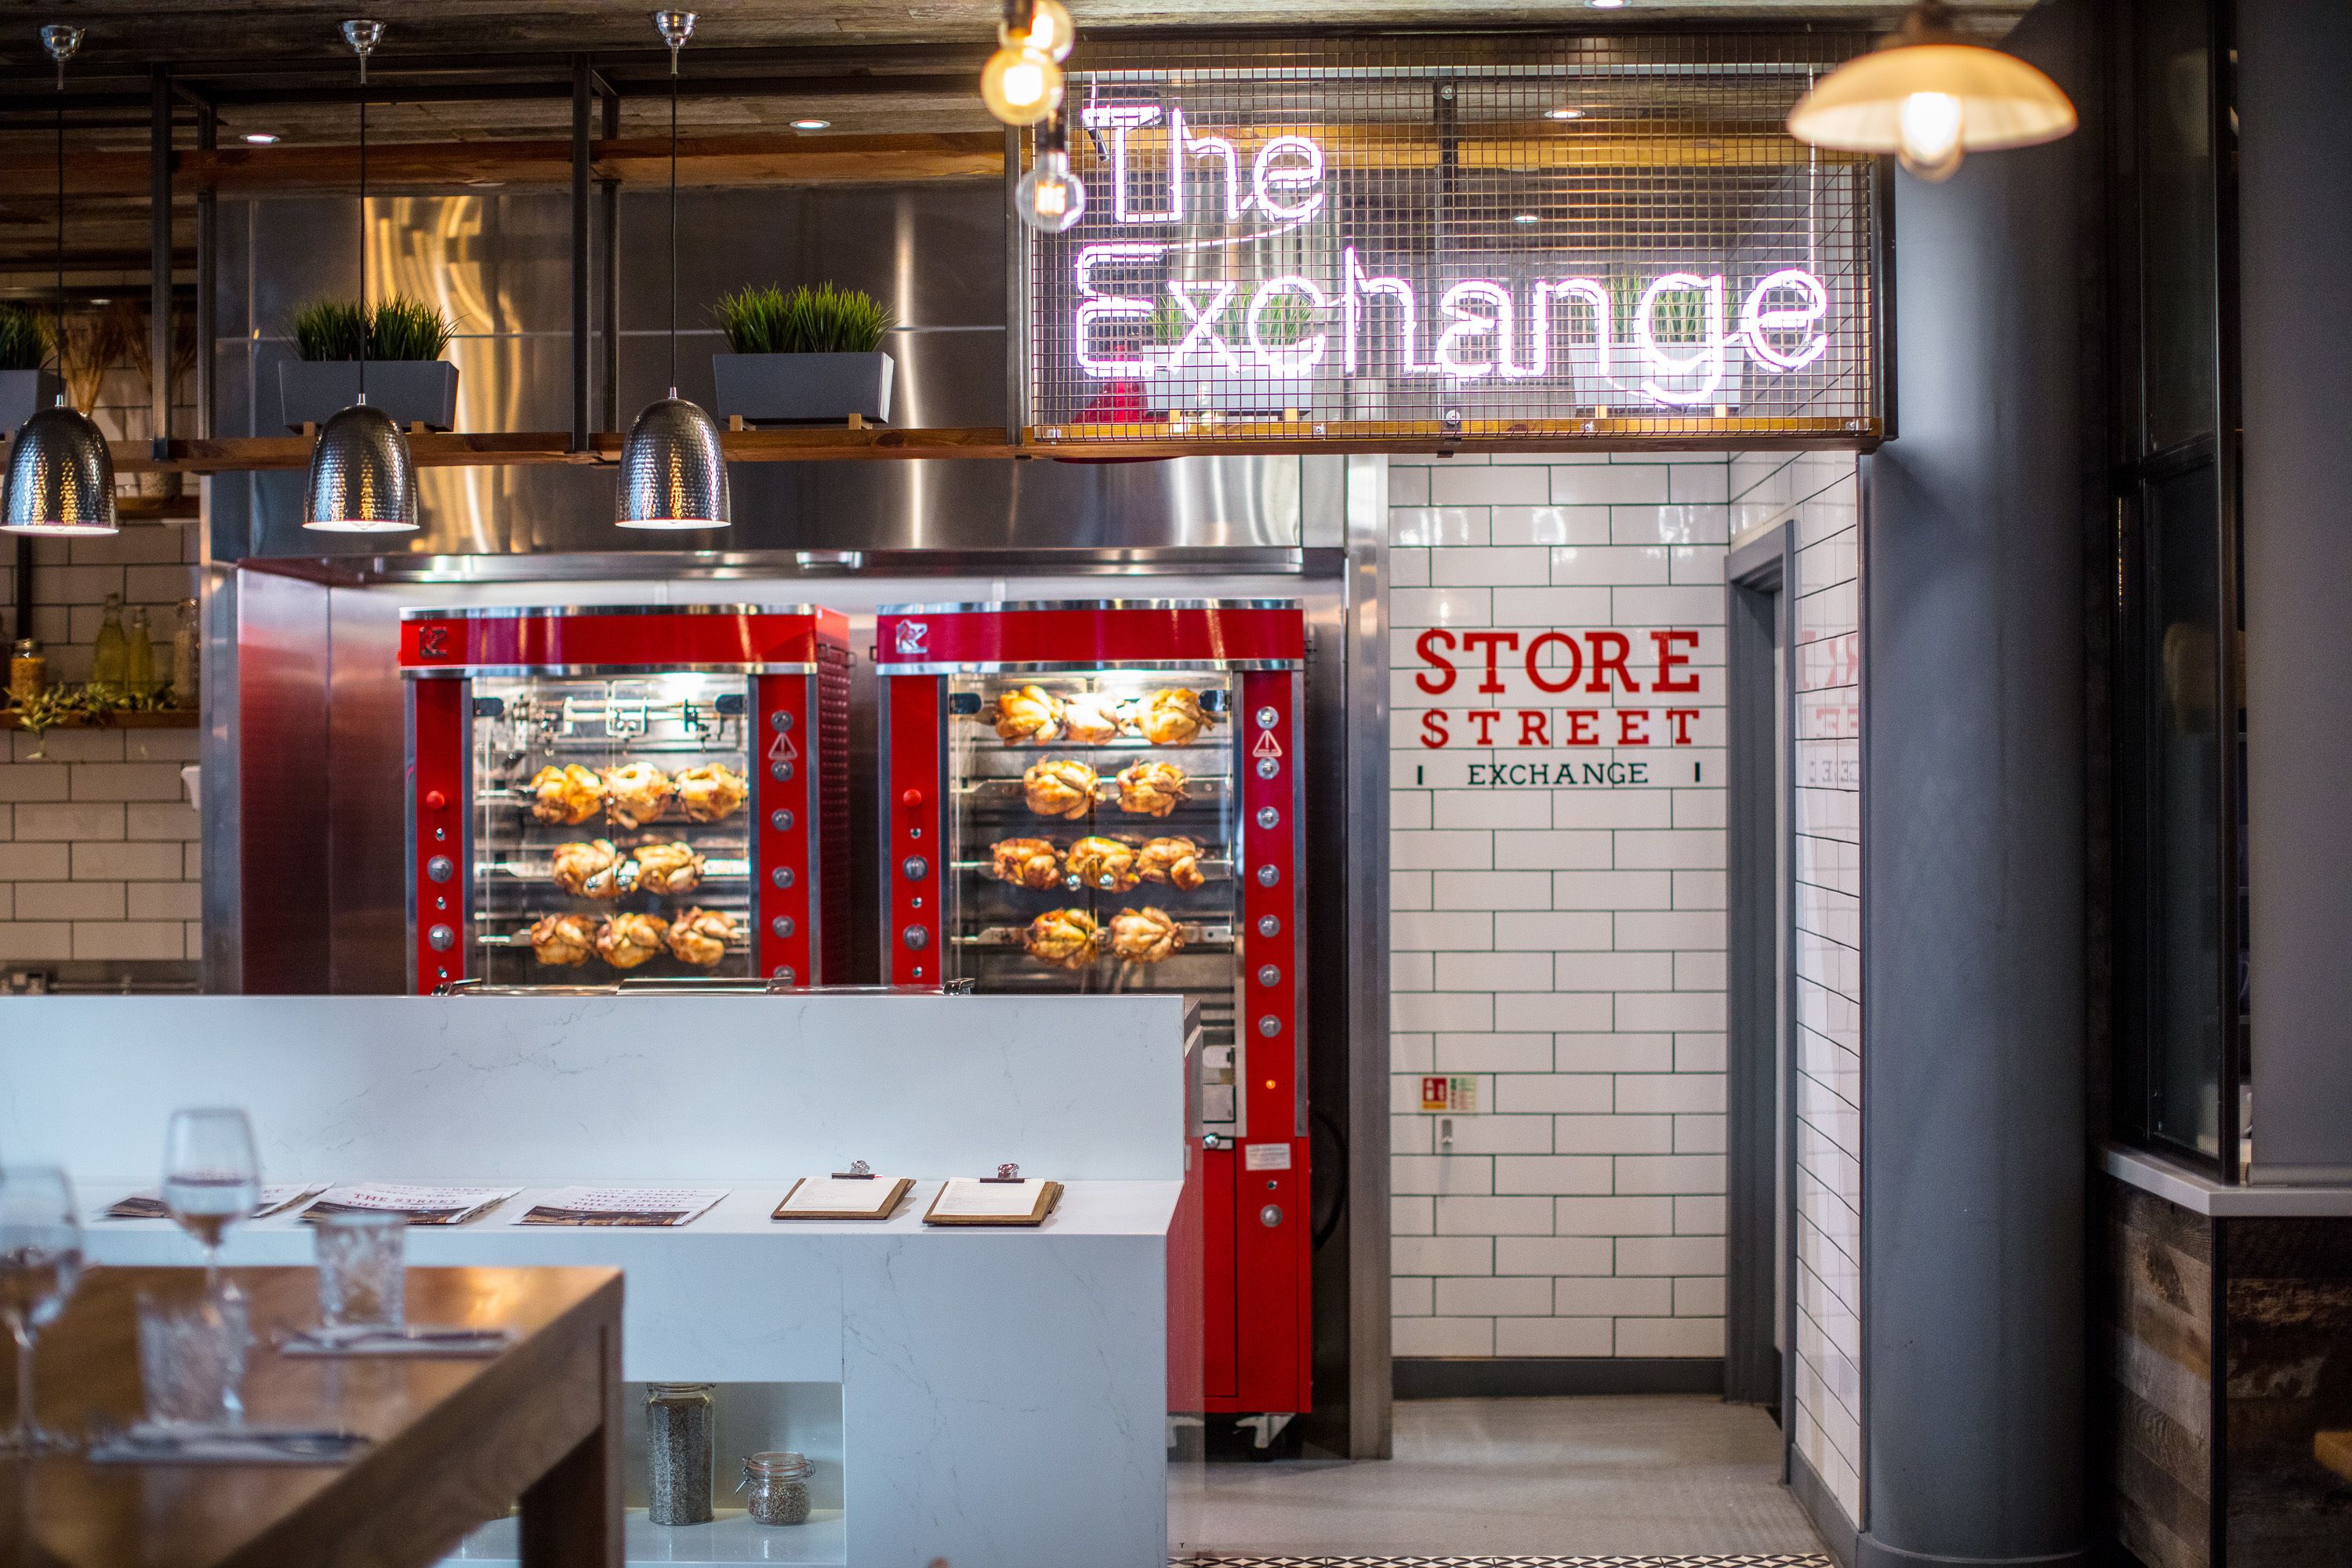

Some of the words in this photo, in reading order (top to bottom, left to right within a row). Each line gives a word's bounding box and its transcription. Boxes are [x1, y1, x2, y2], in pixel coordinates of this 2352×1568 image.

[1080, 104, 1325, 224] The
[1075, 245, 1829, 407] Exchange
[1415, 628, 1700, 695] STORE
[1421, 709, 1700, 749] STREET
[1468, 762, 1649, 786] EXCHANGE
